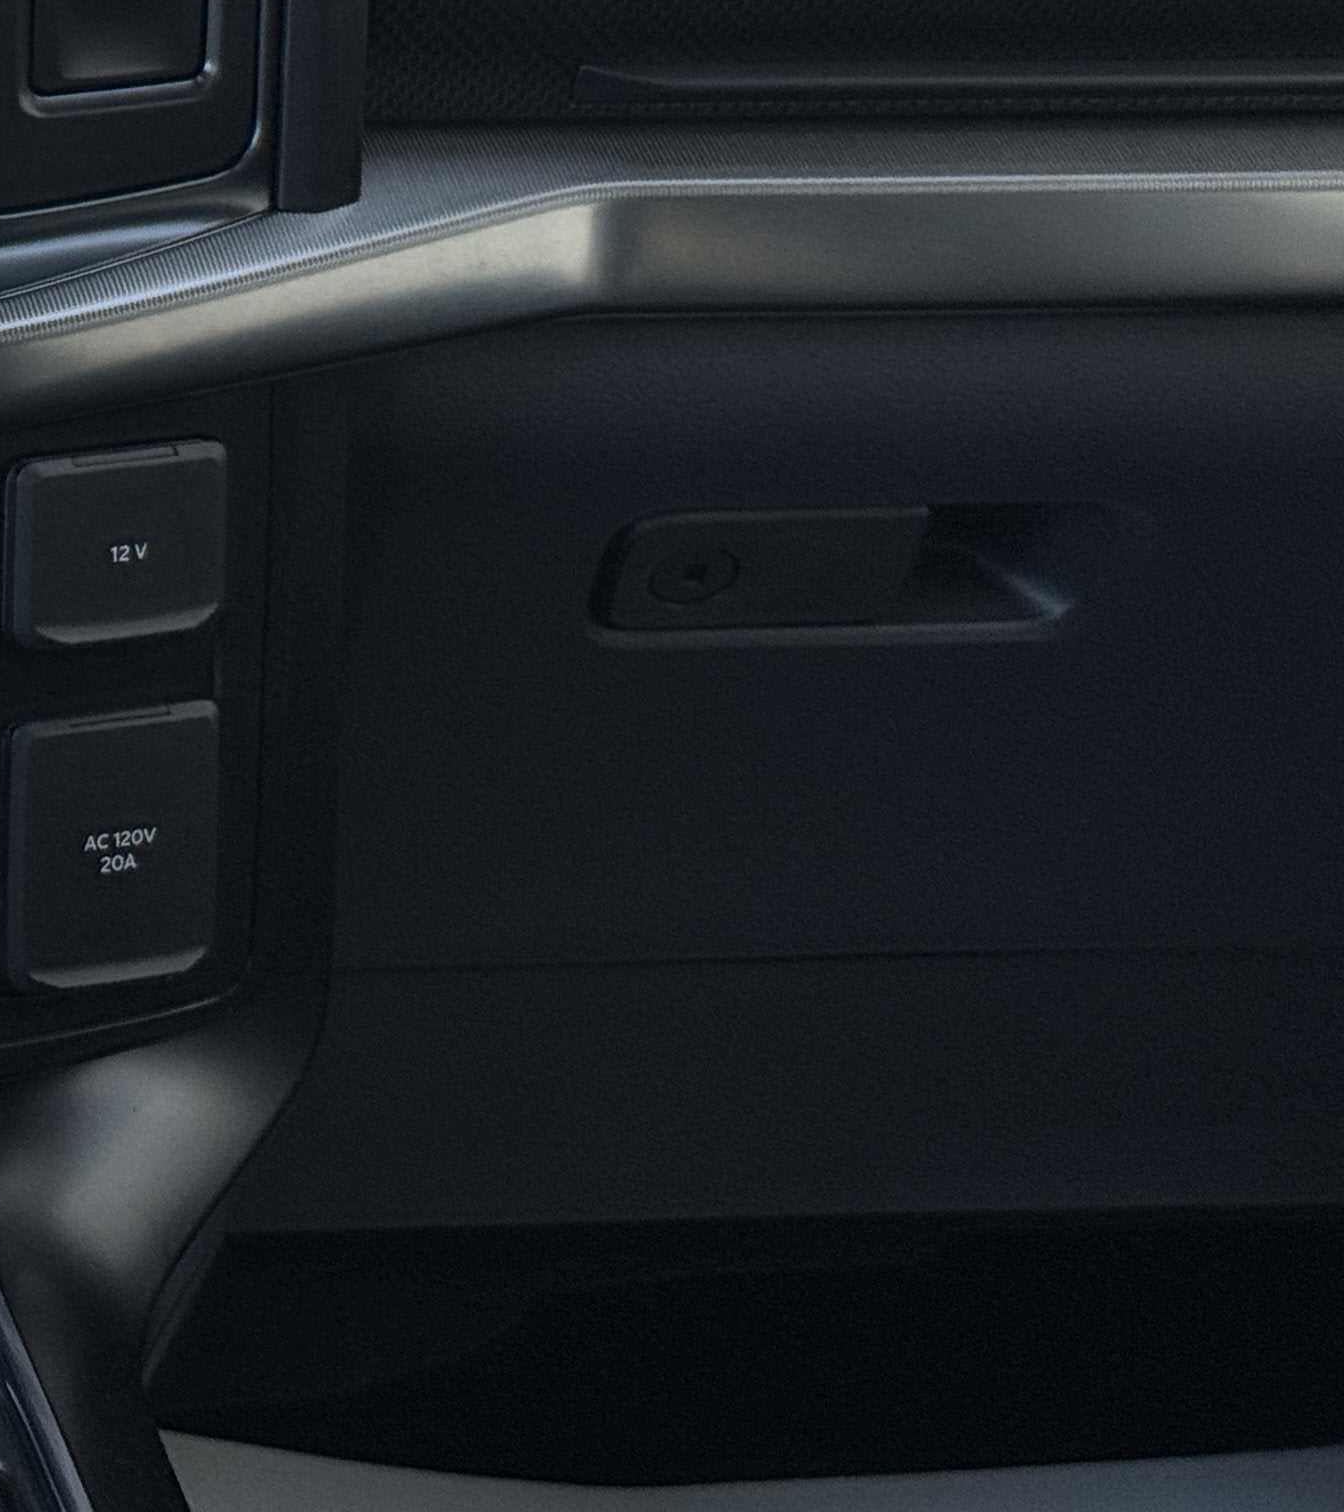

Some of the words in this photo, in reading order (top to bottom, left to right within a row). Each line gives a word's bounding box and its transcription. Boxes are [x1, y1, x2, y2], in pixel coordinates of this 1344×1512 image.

[110, 545, 131, 563] 12
[133, 542, 149, 561] V
[83, 832, 110, 853] AC
[112, 827, 158, 849] 120V
[98, 853, 138, 874] 20A
